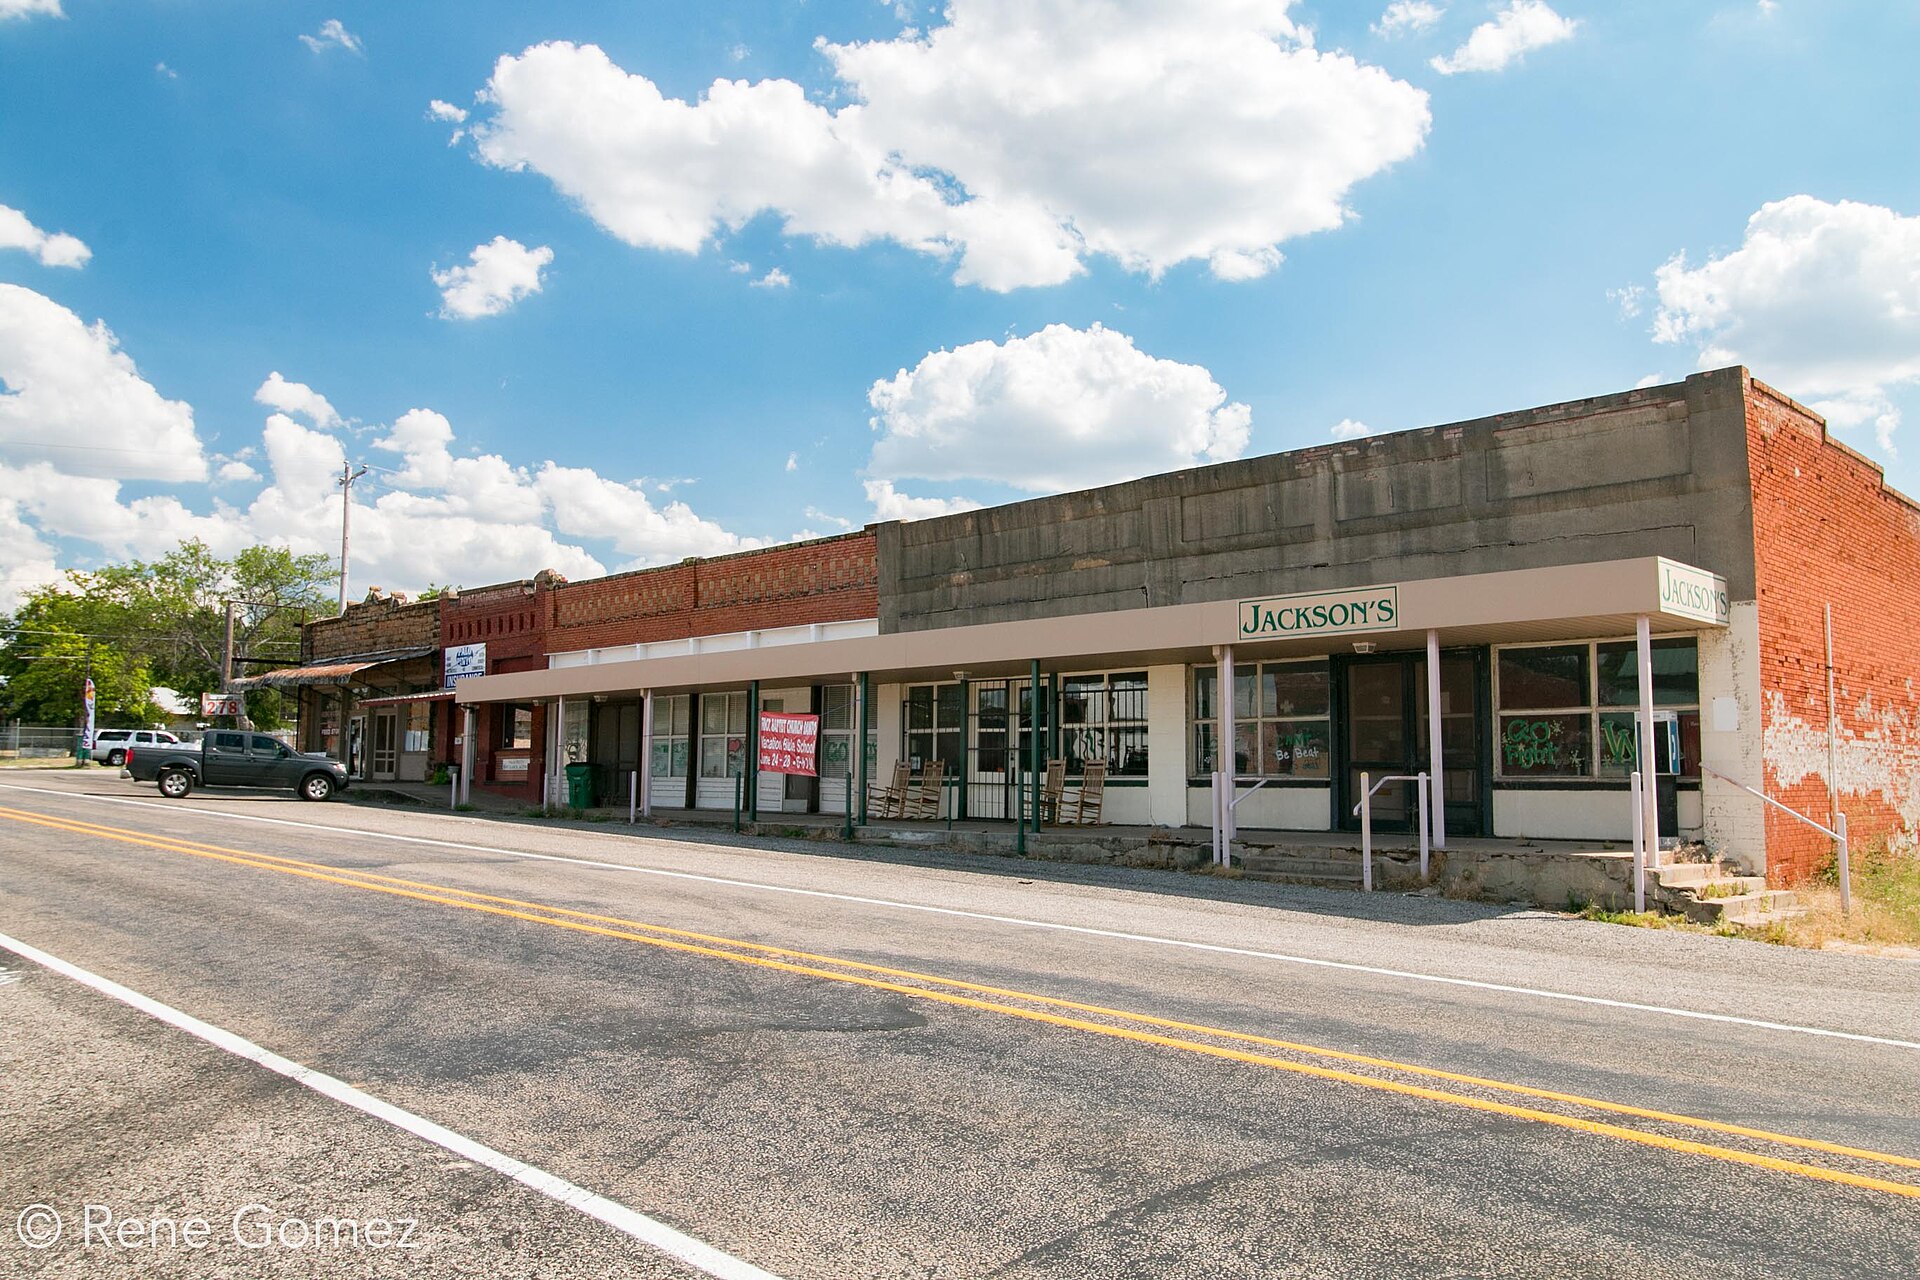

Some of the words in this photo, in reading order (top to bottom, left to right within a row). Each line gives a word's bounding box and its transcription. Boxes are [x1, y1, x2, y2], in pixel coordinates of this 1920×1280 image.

[1663, 569, 1727, 615] JACKSON'S
[1242, 599, 1394, 633] JACKSON'S
[207, 701, 237, 714] 278
[761, 735, 782, 751] Vacation
[796, 739, 816, 754] School
[1294, 746, 1319, 759] Beat
